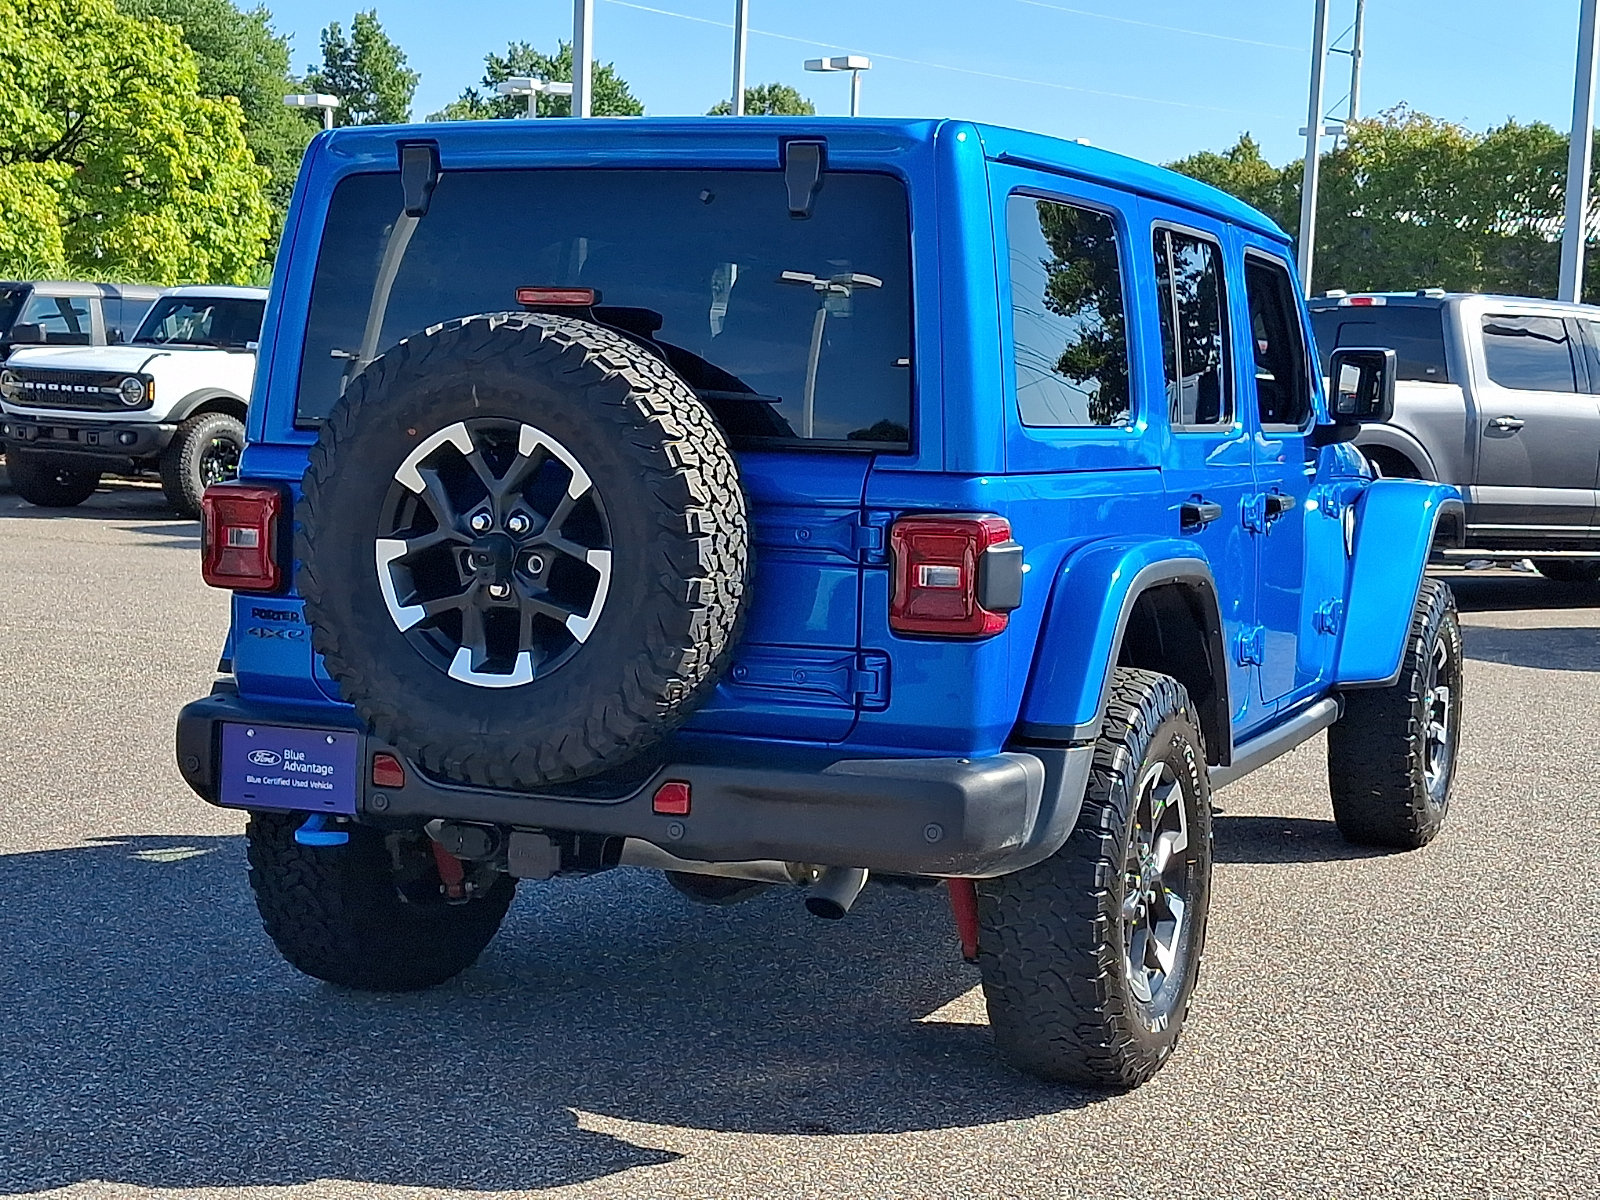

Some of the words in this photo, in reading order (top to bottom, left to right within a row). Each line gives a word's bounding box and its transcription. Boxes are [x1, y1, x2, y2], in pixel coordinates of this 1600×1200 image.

[24, 382, 99, 393] BRONCO
[251, 750, 278, 765] Ford
[283, 749, 305, 761] Blue
[283, 761, 334, 776] Advantage
[246, 775, 262, 784] Blue
[262, 777, 291, 787] Certified
[291, 779, 308, 788] Used
[309, 781, 334, 790] Vehicle
